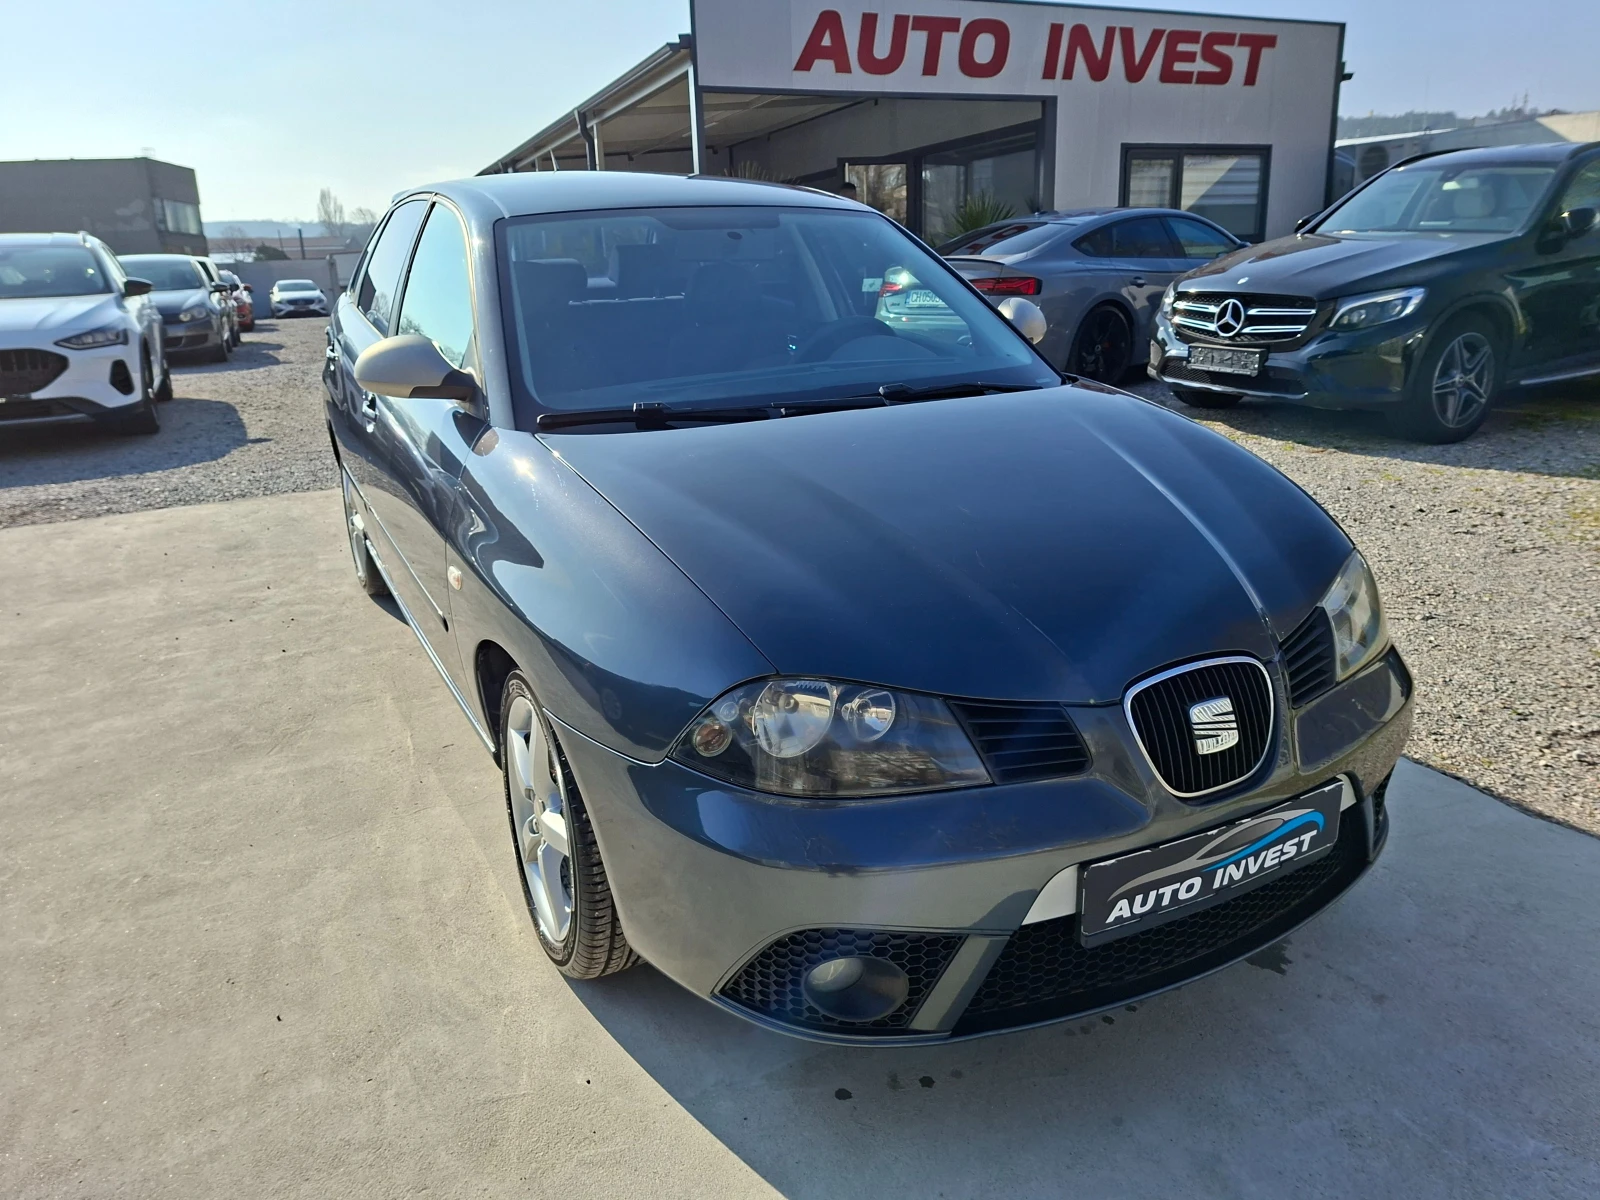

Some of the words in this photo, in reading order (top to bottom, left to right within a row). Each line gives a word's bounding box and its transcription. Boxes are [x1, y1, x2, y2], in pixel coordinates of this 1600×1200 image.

[793, 9, 1010, 78] AUTO
[1041, 22, 1278, 86] INVEST
[1105, 876, 1202, 923] AUTO
[1212, 830, 1317, 889] INVEST
